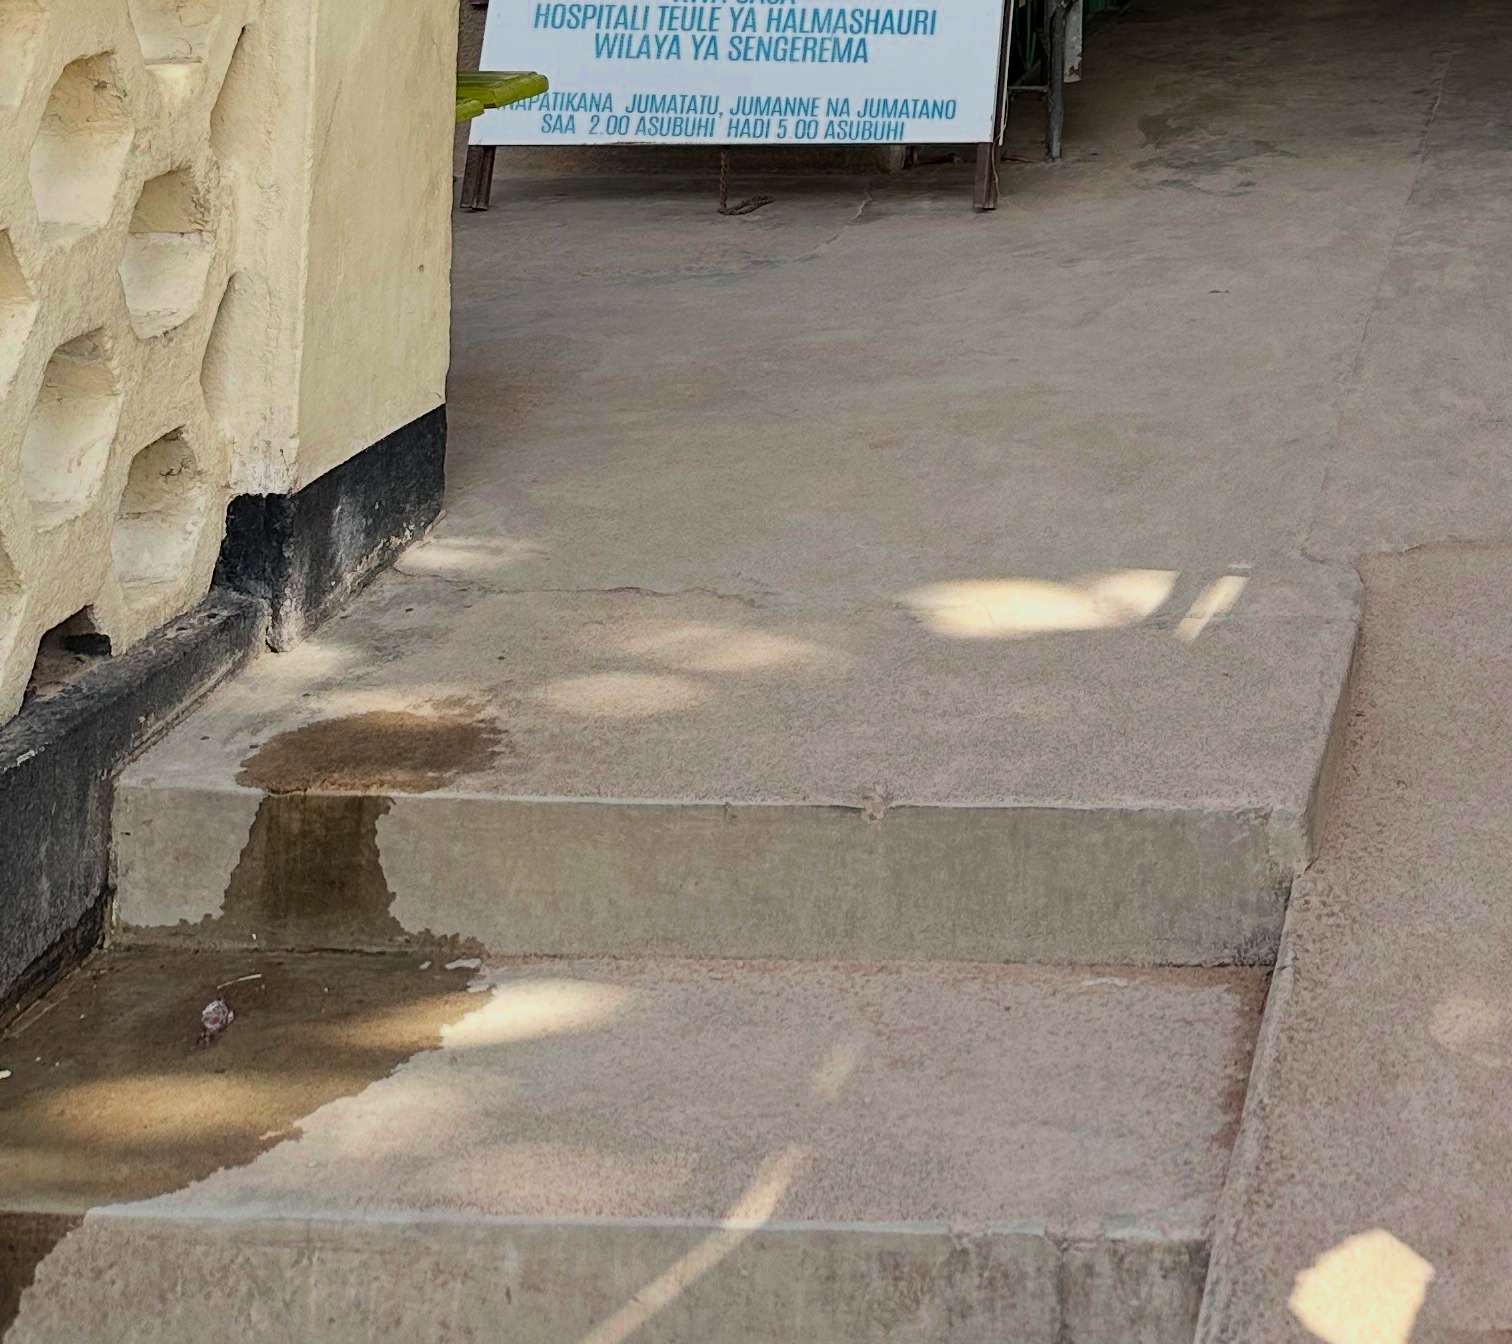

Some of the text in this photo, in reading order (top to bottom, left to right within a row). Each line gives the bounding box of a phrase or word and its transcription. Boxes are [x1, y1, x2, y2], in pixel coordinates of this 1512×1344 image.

[533, 2, 938, 37] HOSPITALI TEULE YA HALMASHAURI
[593, 32, 870, 64] WILAYA YA SENGEREMA
[624, 93, 725, 119] JUMATATU,
[729, 95, 821, 118] JUMANNE
[825, 97, 852, 118] NA
[857, 97, 958, 120] JUMATANO
[541, 114, 577, 135] SAA
[588, 115, 631, 136] 2.00
[634, 117, 715, 138] ASUBUHI
[726, 119, 772, 140] HADI
[824, 120, 905, 142] ASUBUHI
